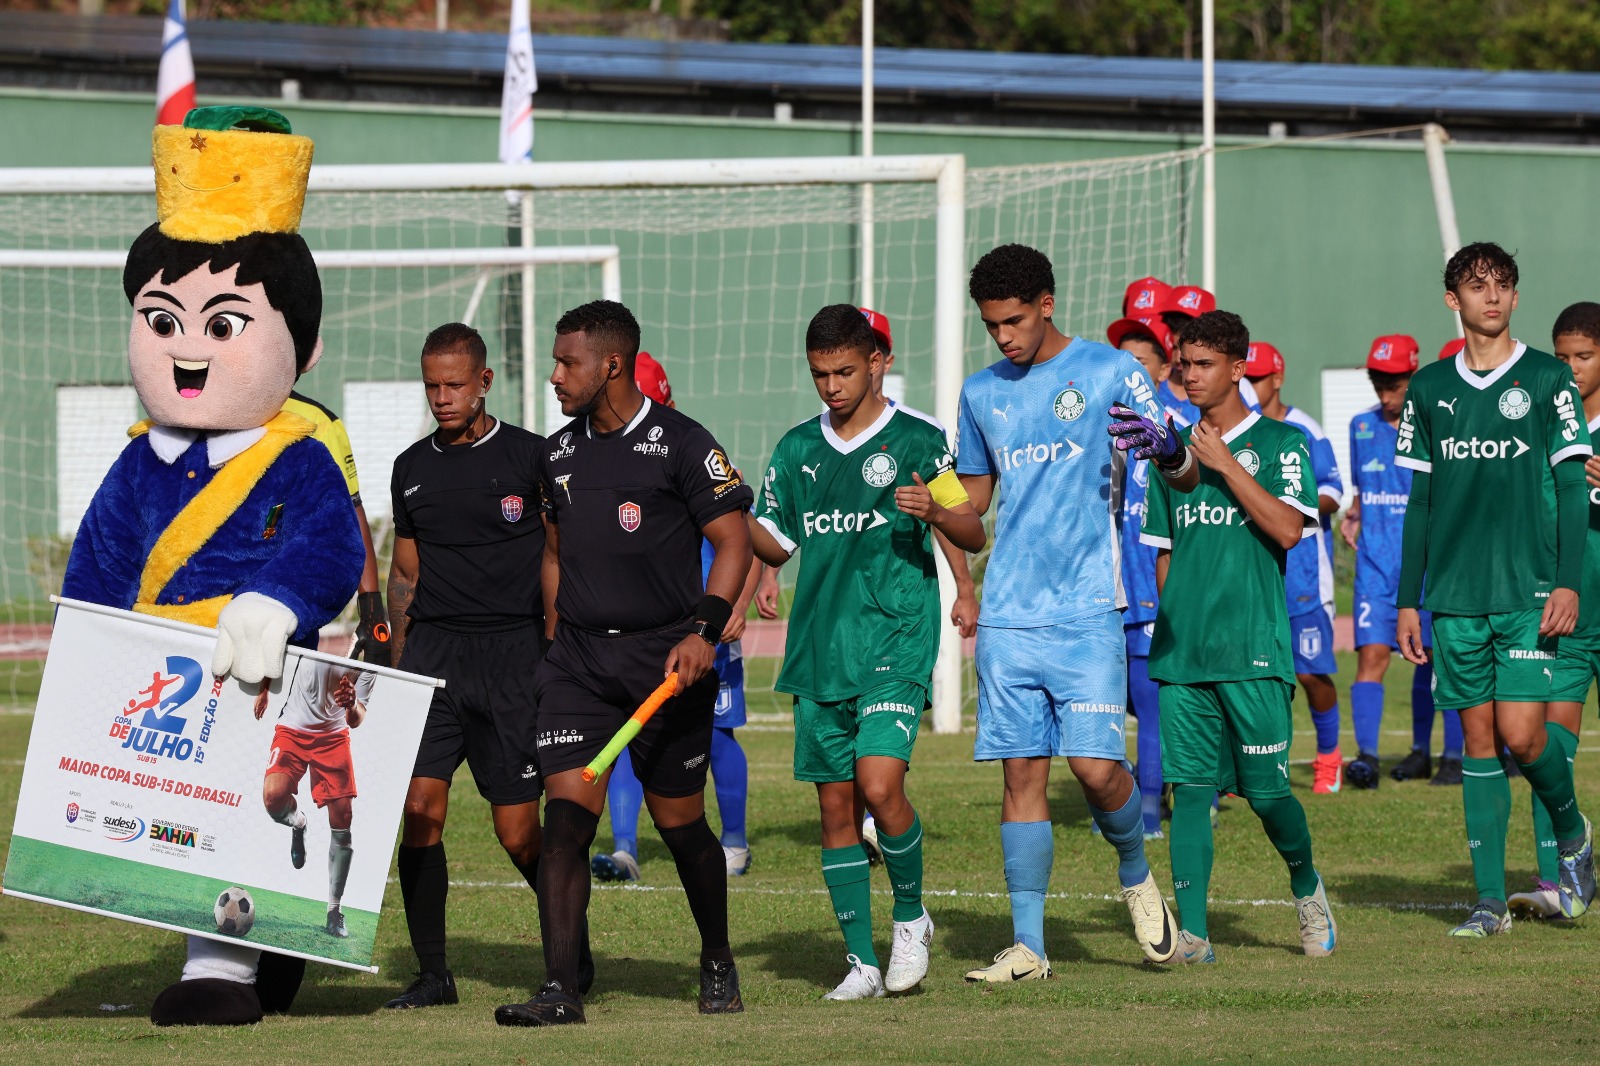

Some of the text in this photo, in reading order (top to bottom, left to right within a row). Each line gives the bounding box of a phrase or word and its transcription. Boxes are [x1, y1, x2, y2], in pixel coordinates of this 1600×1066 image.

[1055, 402, 1085, 421] PALMEIRAS
[1501, 401, 1529, 418] PALMEIRAS
[633, 442, 669, 455] alpha
[864, 466, 895, 486] PALMEIRAS
[713, 477, 740, 494] SPOR
[1359, 602, 1372, 628] 2
[140, 656, 203, 735] 2
[114, 716, 132, 725] COPA
[199, 699, 218, 743] EDIÇÃO
[109, 722, 194, 761] DE JULHO
[540, 729, 578, 739] GRUPO
[554, 735, 584, 745] FORTE
[137, 754, 158, 765] SUB 15
[59, 756, 242, 807] MAIOR COPA SUB-15 DO BRASIL!
[103, 815, 137, 830] sudesb
[149, 824, 196, 848] BAHIA
[1175, 880, 1190, 889] SEP
[838, 910, 855, 920] SEP
